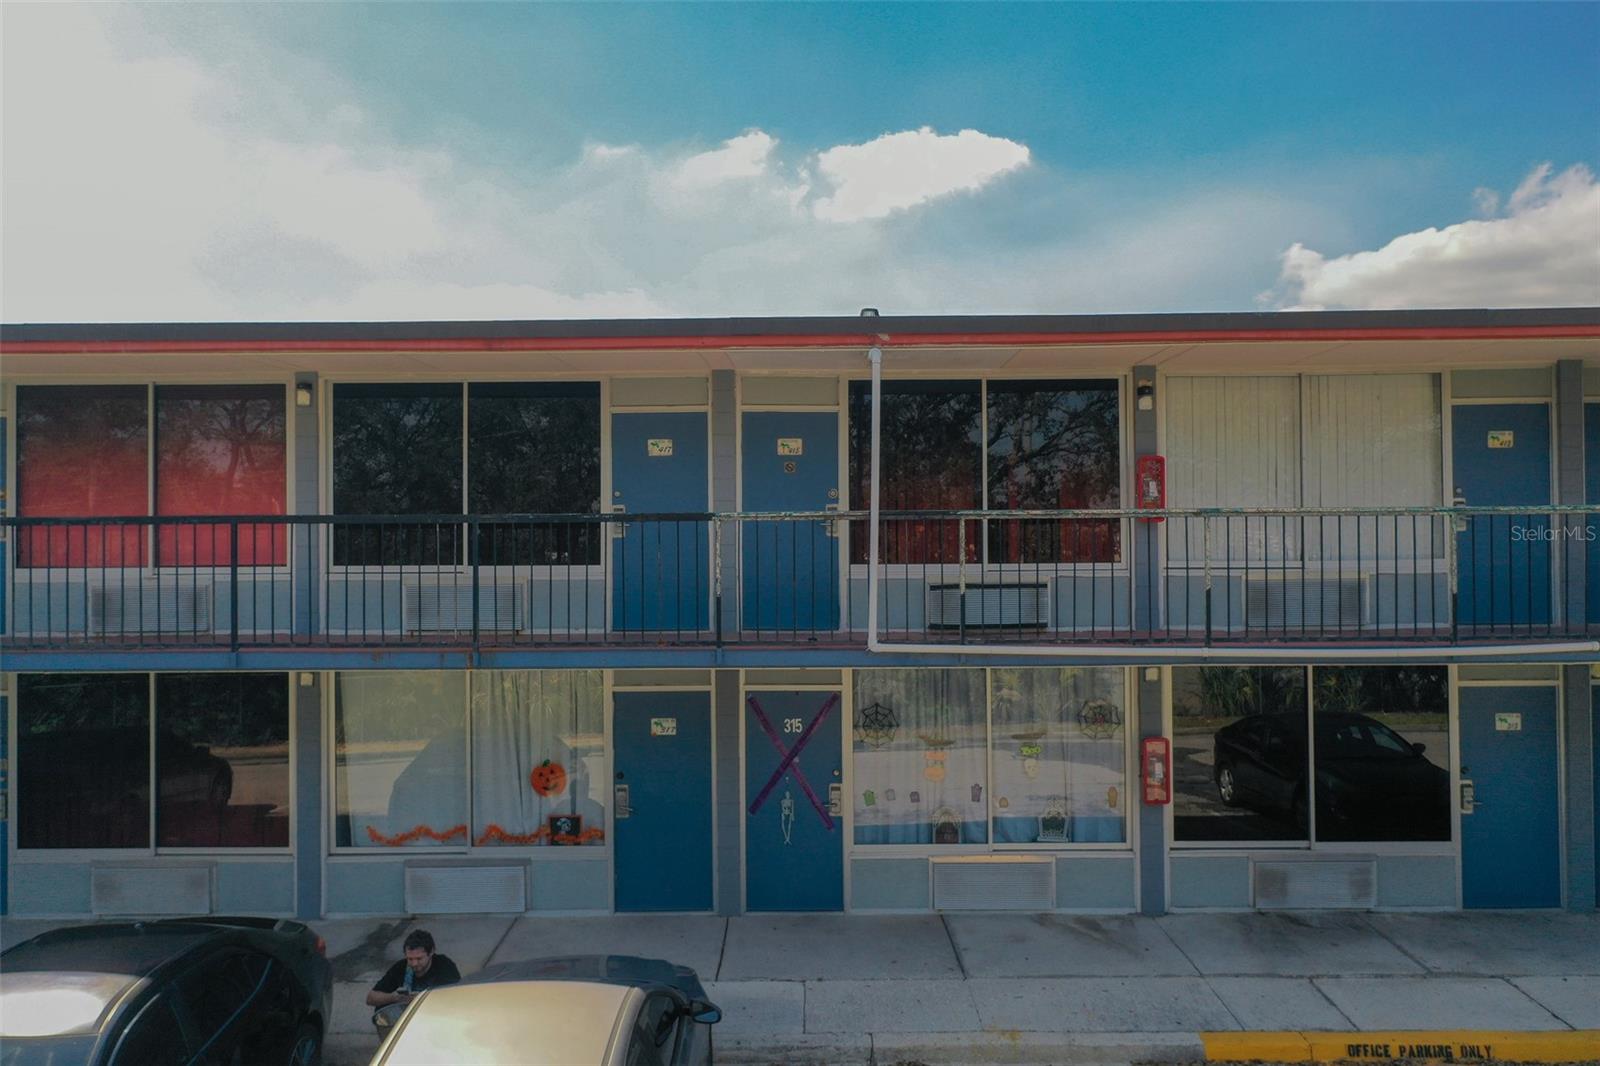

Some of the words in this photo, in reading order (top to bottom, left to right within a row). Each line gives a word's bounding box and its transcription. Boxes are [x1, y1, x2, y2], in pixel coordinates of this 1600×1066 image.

[657, 446, 672, 454] 417
[783, 718, 803, 733] 315
[1347, 1044, 1391, 1058] OFFICE
[1399, 1044, 1453, 1060] PARKING
[1460, 1045, 1492, 1059] ONLY
